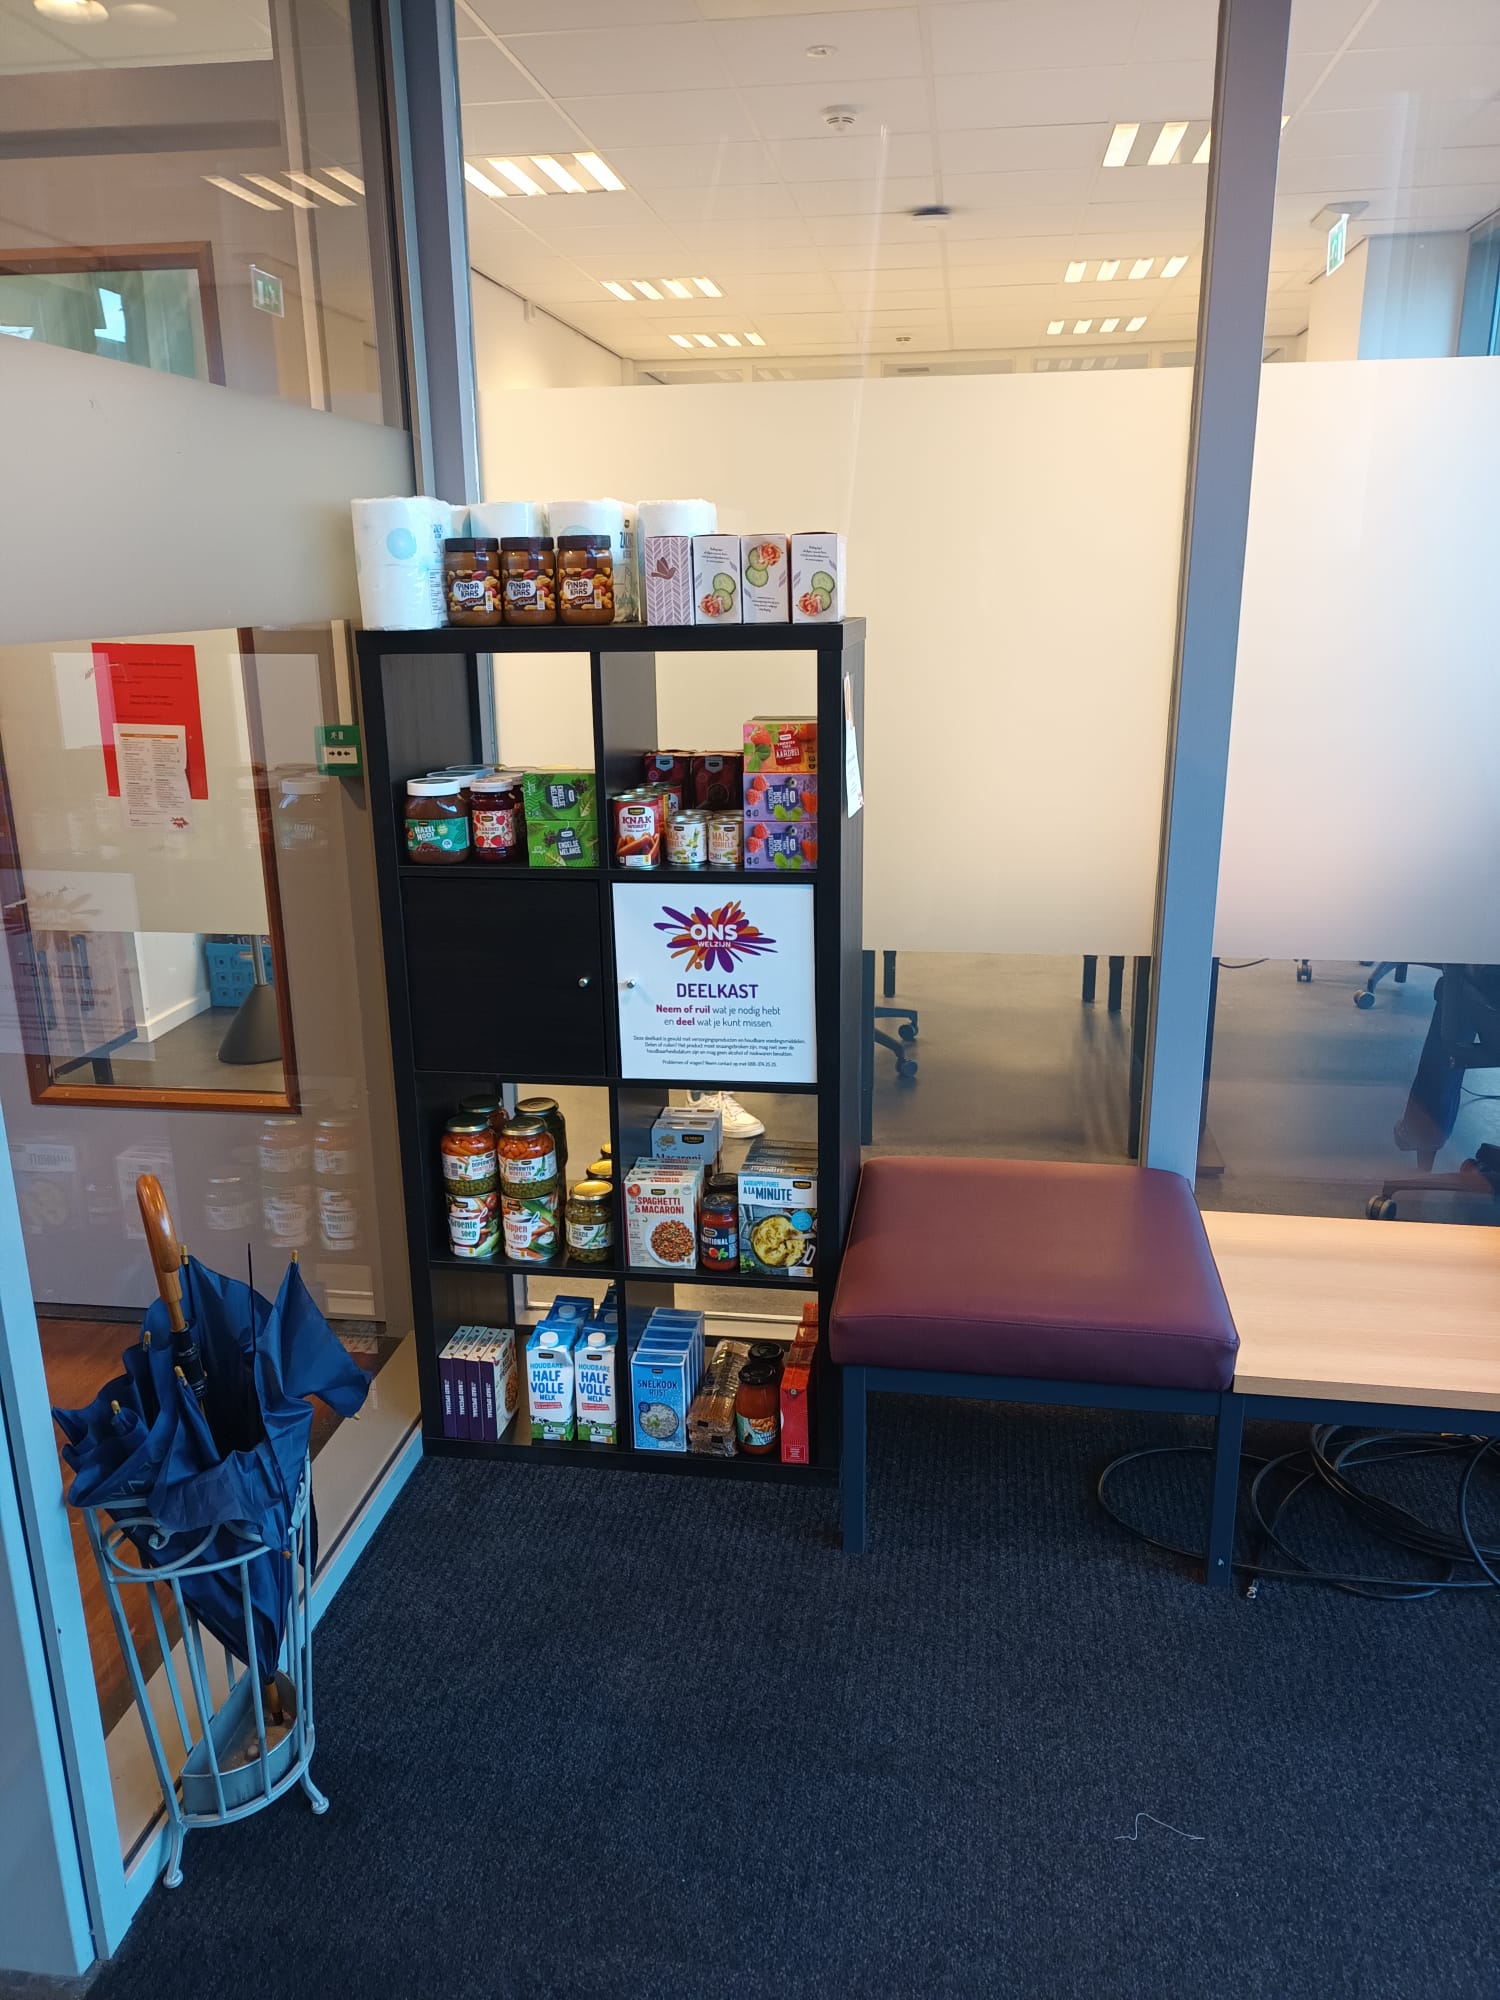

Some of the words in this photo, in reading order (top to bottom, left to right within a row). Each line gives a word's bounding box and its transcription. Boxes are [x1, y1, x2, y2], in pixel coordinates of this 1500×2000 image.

[456, 581, 479, 590] PINDA
[508, 581, 531, 590] PINDA
[565, 580, 589, 589] PINDA
[460, 589, 479, 598] KAAS
[513, 589, 531, 598] KAAS
[570, 588, 588, 597] KAAS
[622, 816, 652, 824] KNAK
[414, 826, 435, 834] HAZEL
[712, 832, 729, 841] MAIS
[690, 924, 738, 941] ONS
[676, 983, 759, 999] DEELKAST
[656, 1004, 682, 1014] Neem
[683, 1004, 694, 1014] of
[695, 1004, 711, 1014] ruil
[712, 1006, 727, 1014] wat
[729, 1006, 737, 1017] je
[738, 1005, 761, 1017] nodig
[762, 1006, 781, 1015] hebt
[676, 1017, 695, 1026] deel
[696, 1018, 711, 1026] wat
[713, 1018, 721, 1028] je
[722, 1018, 741, 1027] kunt
[742, 1019, 773, 1028] missen.
[748, 1187, 756, 1195] LA
[755, 1187, 792, 1201] MINUTE
[637, 1196, 681, 1206] SPAGHETTI
[641, 1205, 684, 1214] MACARONI
[461, 1230, 477, 1238] soep
[513, 1233, 528, 1242] soep
[579, 1364, 610, 1372] HOUDBARE
[533, 1370, 561, 1382] HALF
[581, 1371, 608, 1384] HALF
[530, 1382, 564, 1394] VOLLE
[637, 1380, 678, 1389] SNELKOOK
[578, 1383, 611, 1397] VOLLE
